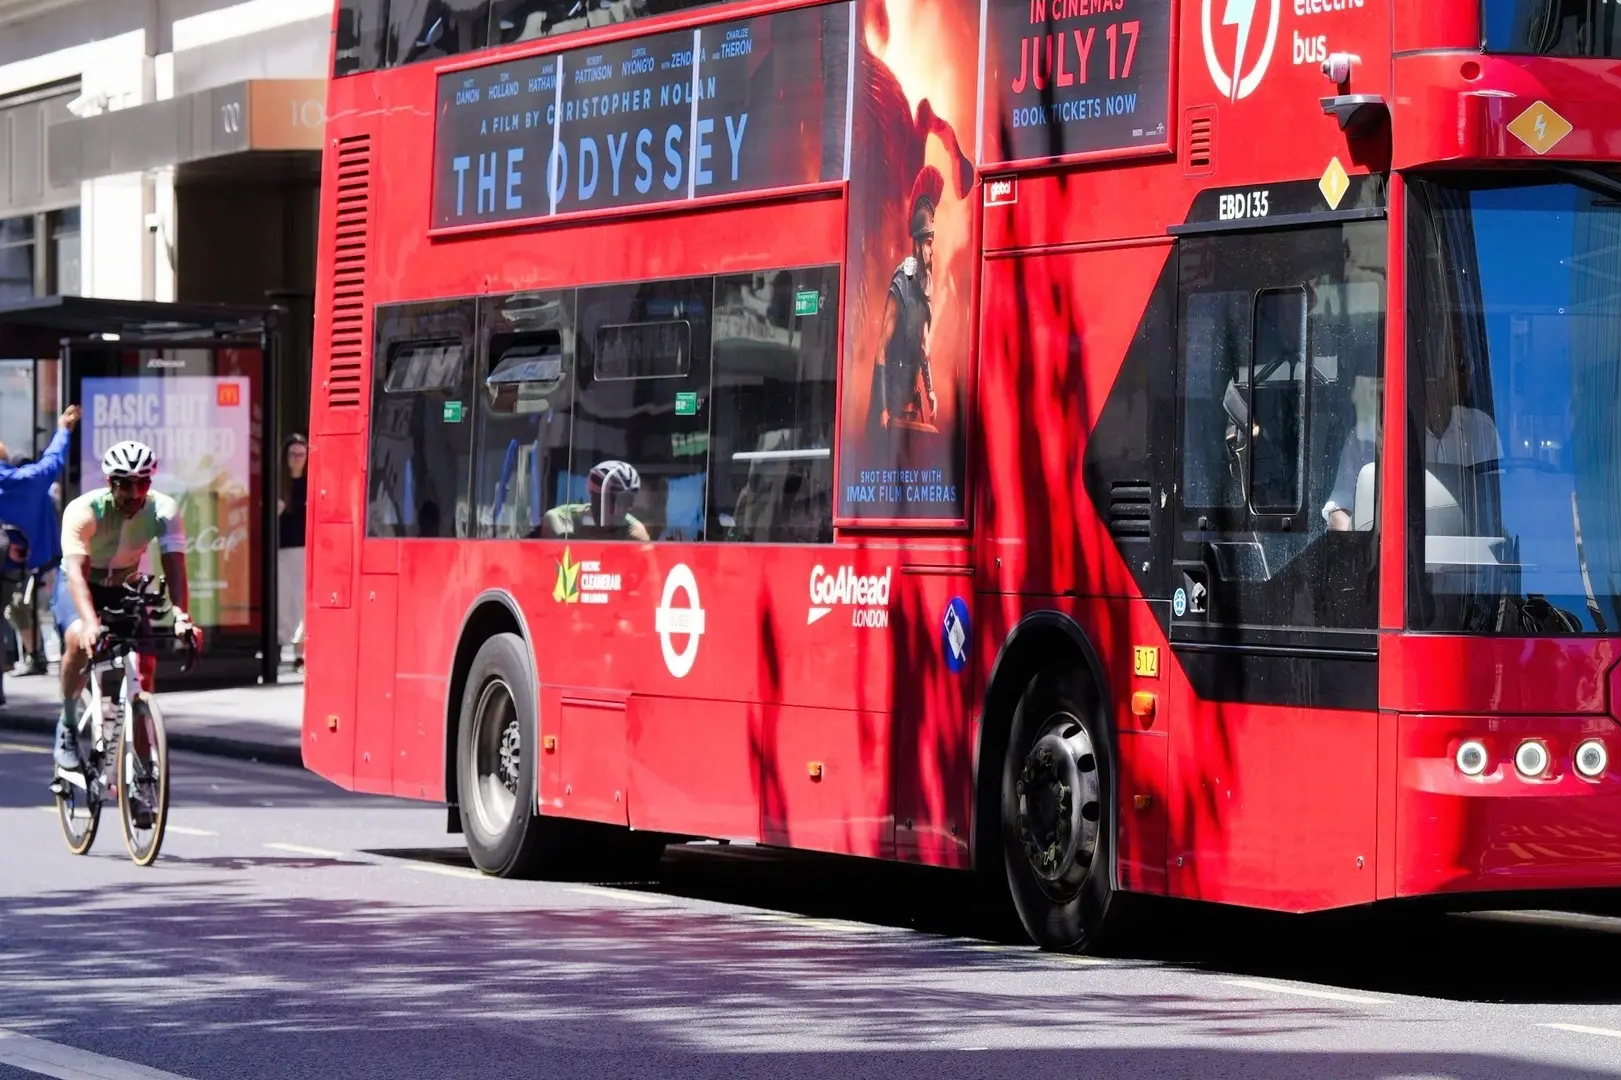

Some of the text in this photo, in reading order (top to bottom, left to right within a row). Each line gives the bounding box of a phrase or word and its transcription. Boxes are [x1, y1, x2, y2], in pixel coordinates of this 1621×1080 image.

[720, 39, 752, 59] THERON
[1011, 21, 1140, 94] JULY 17
[1293, 30, 1327, 65] bus
[671, 51, 706, 69] ZENDAA
[528, 73, 566, 93] HATHAWY
[575, 64, 613, 85] PATTINSON
[456, 88, 480, 106] DAMON
[488, 81, 519, 100] HOLLAND
[480, 119, 487, 136] A
[493, 114, 519, 134] FILM
[525, 110, 540, 129] BY
[660, 76, 716, 107] NOLAN
[1013, 93, 1137, 128] BOOK TICKETS NOW
[452, 113, 749, 216] THE ODYSSEY
[1219, 191, 1269, 220] EBD135
[93, 394, 209, 427] BASIC BUT
[860, 470, 941, 483] SHOT ENTIRELY WITH
[846, 485, 957, 503] IMAX FILM CAMERAS
[809, 565, 892, 605] GoAhead
[852, 609, 889, 628] LONDON
[1135, 649, 1156, 671] 312
